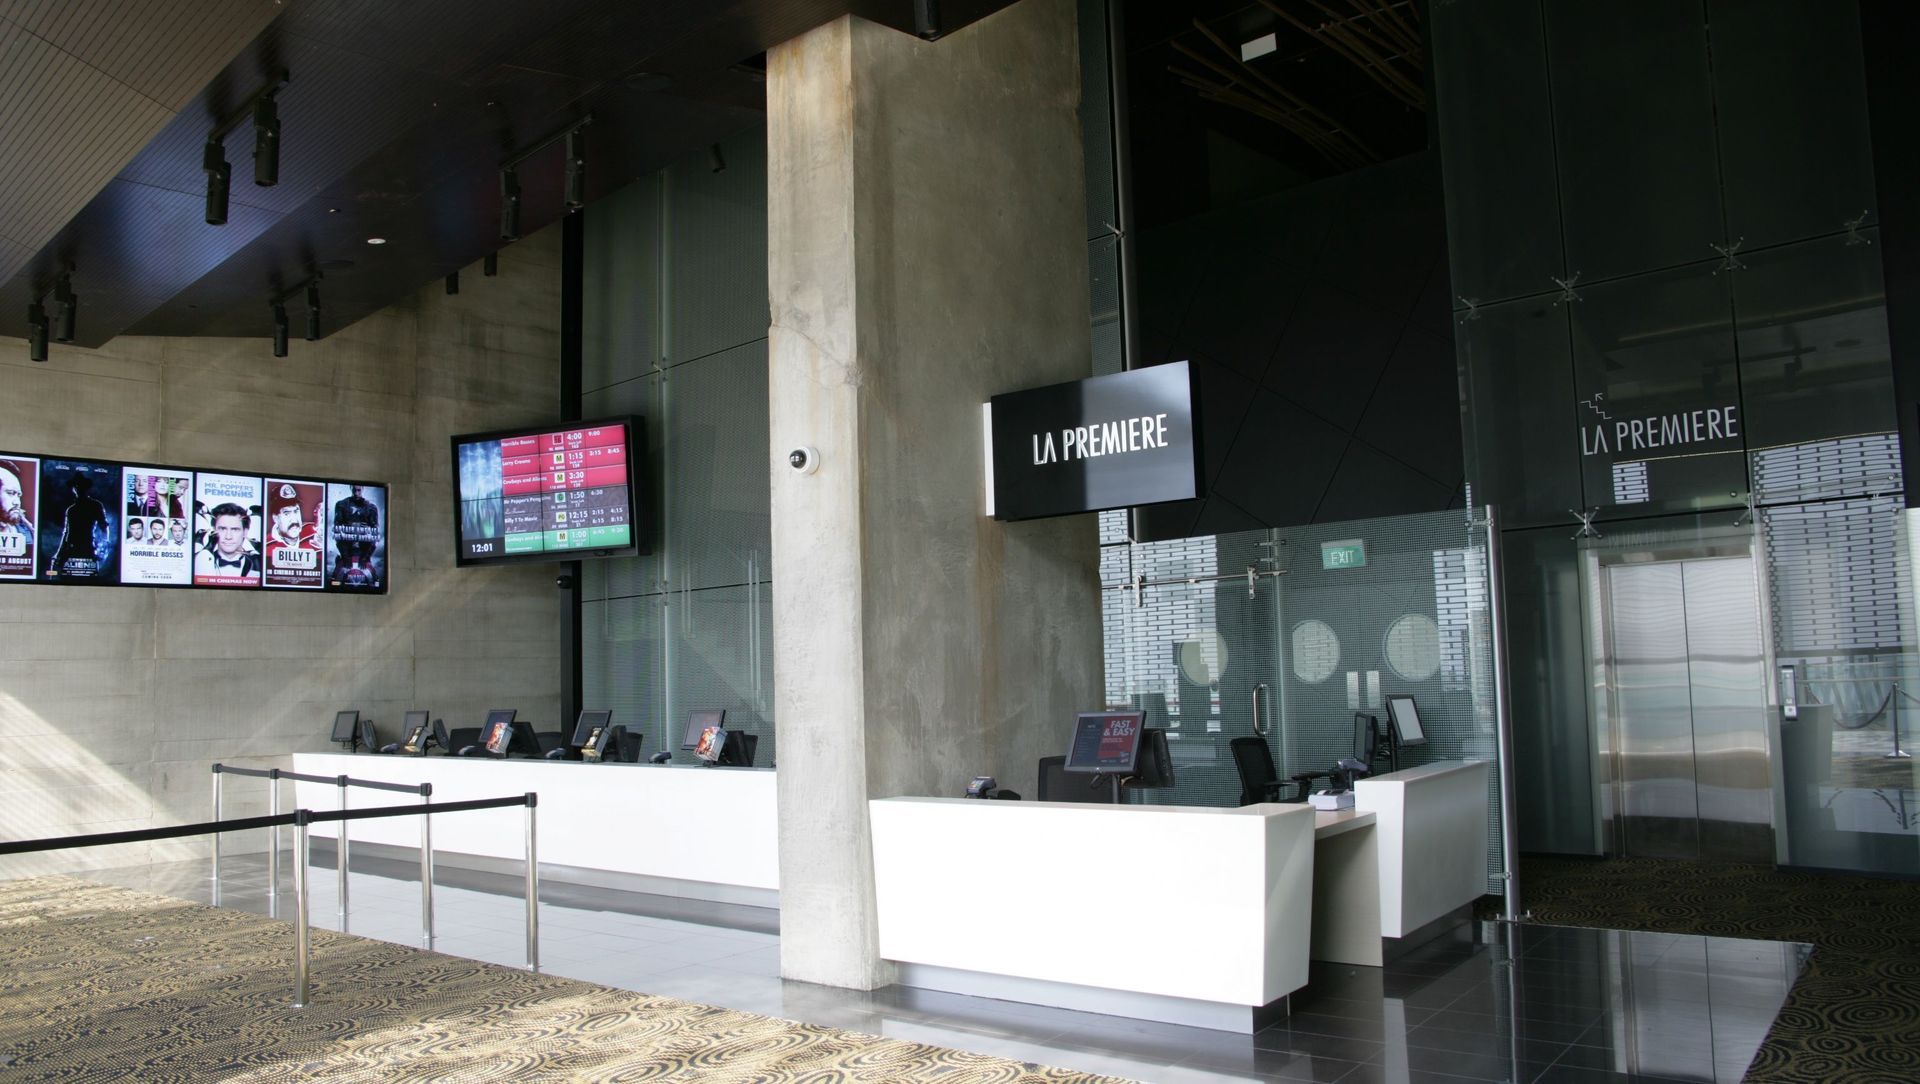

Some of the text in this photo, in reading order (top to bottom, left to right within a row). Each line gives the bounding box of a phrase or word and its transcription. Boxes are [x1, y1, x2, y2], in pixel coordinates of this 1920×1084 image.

[1581, 405, 1738, 456] LA PREMIERE
[567, 432, 582, 440] 4:00
[1033, 413, 1168, 465] LA PREMIERE
[568, 452, 583, 460] 1:15
[568, 471, 584, 479] 3:30
[570, 491, 585, 499] 1:50
[568, 510, 588, 519] 12:15
[471, 543, 493, 553] 12:01
[7, 557, 32, 565] AUGUST
[278, 551, 311, 562] BILLY T
[1330, 550, 1355, 566] EXIT
[1110, 720, 1131, 728] FAST
[1103, 727, 1135, 736] & EASY
